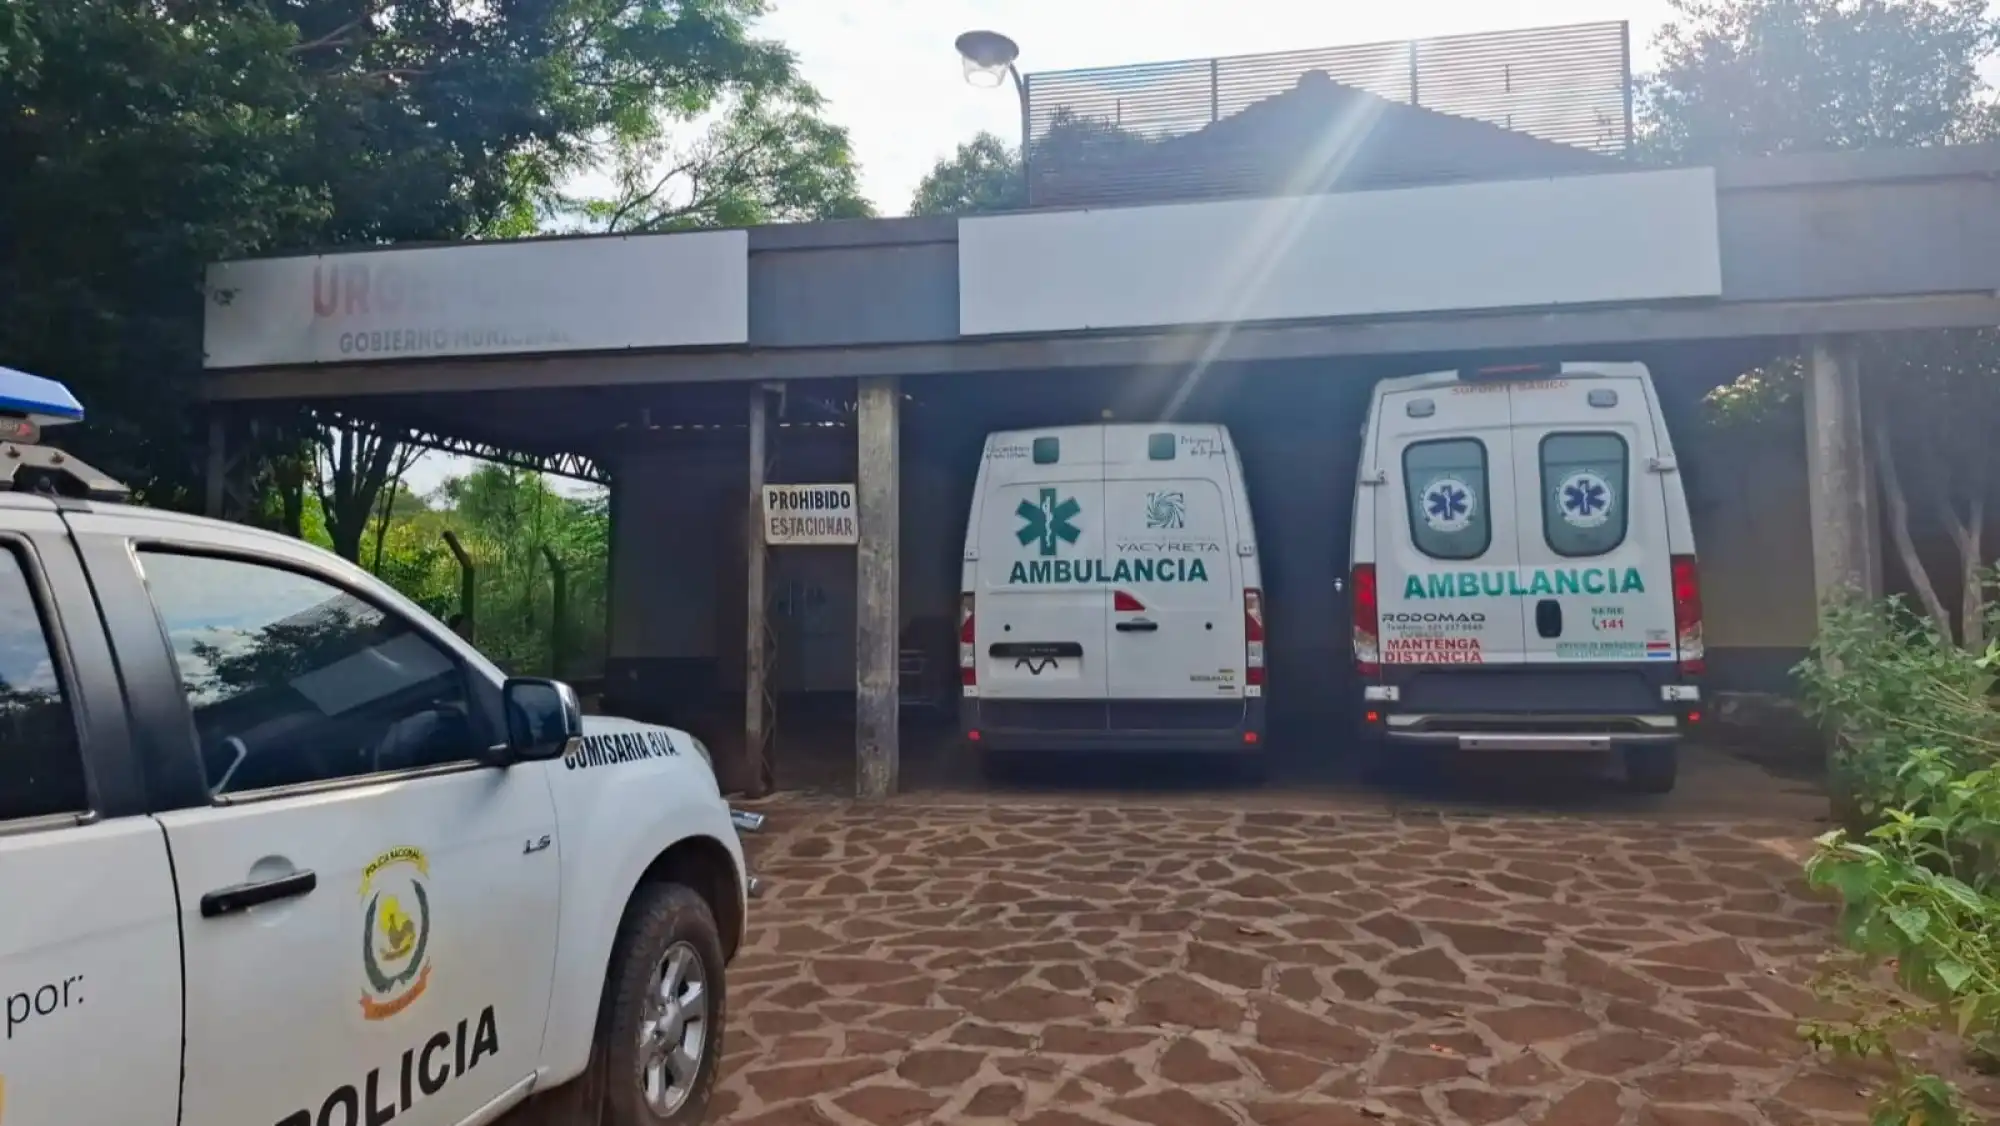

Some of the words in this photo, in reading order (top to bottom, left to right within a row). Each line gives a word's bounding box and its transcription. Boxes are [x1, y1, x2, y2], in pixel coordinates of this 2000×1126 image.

[340, 328, 448, 354] GOBIERNO
[769, 490, 851, 510] PROHIBIDO
[770, 516, 853, 536] ESTACIONAR
[1116, 541, 1221, 553] YACYRETA
[1009, 557, 1209, 584] AMBULANCIA
[1403, 567, 1645, 600] AMBULANCIA
[1600, 618, 1625, 630] 141
[1387, 638, 1481, 650] MANTENGA
[1384, 651, 1484, 664] DISTANCIA
[6, 974, 85, 1039] por:
[274, 1005, 499, 1126] OLICIA
